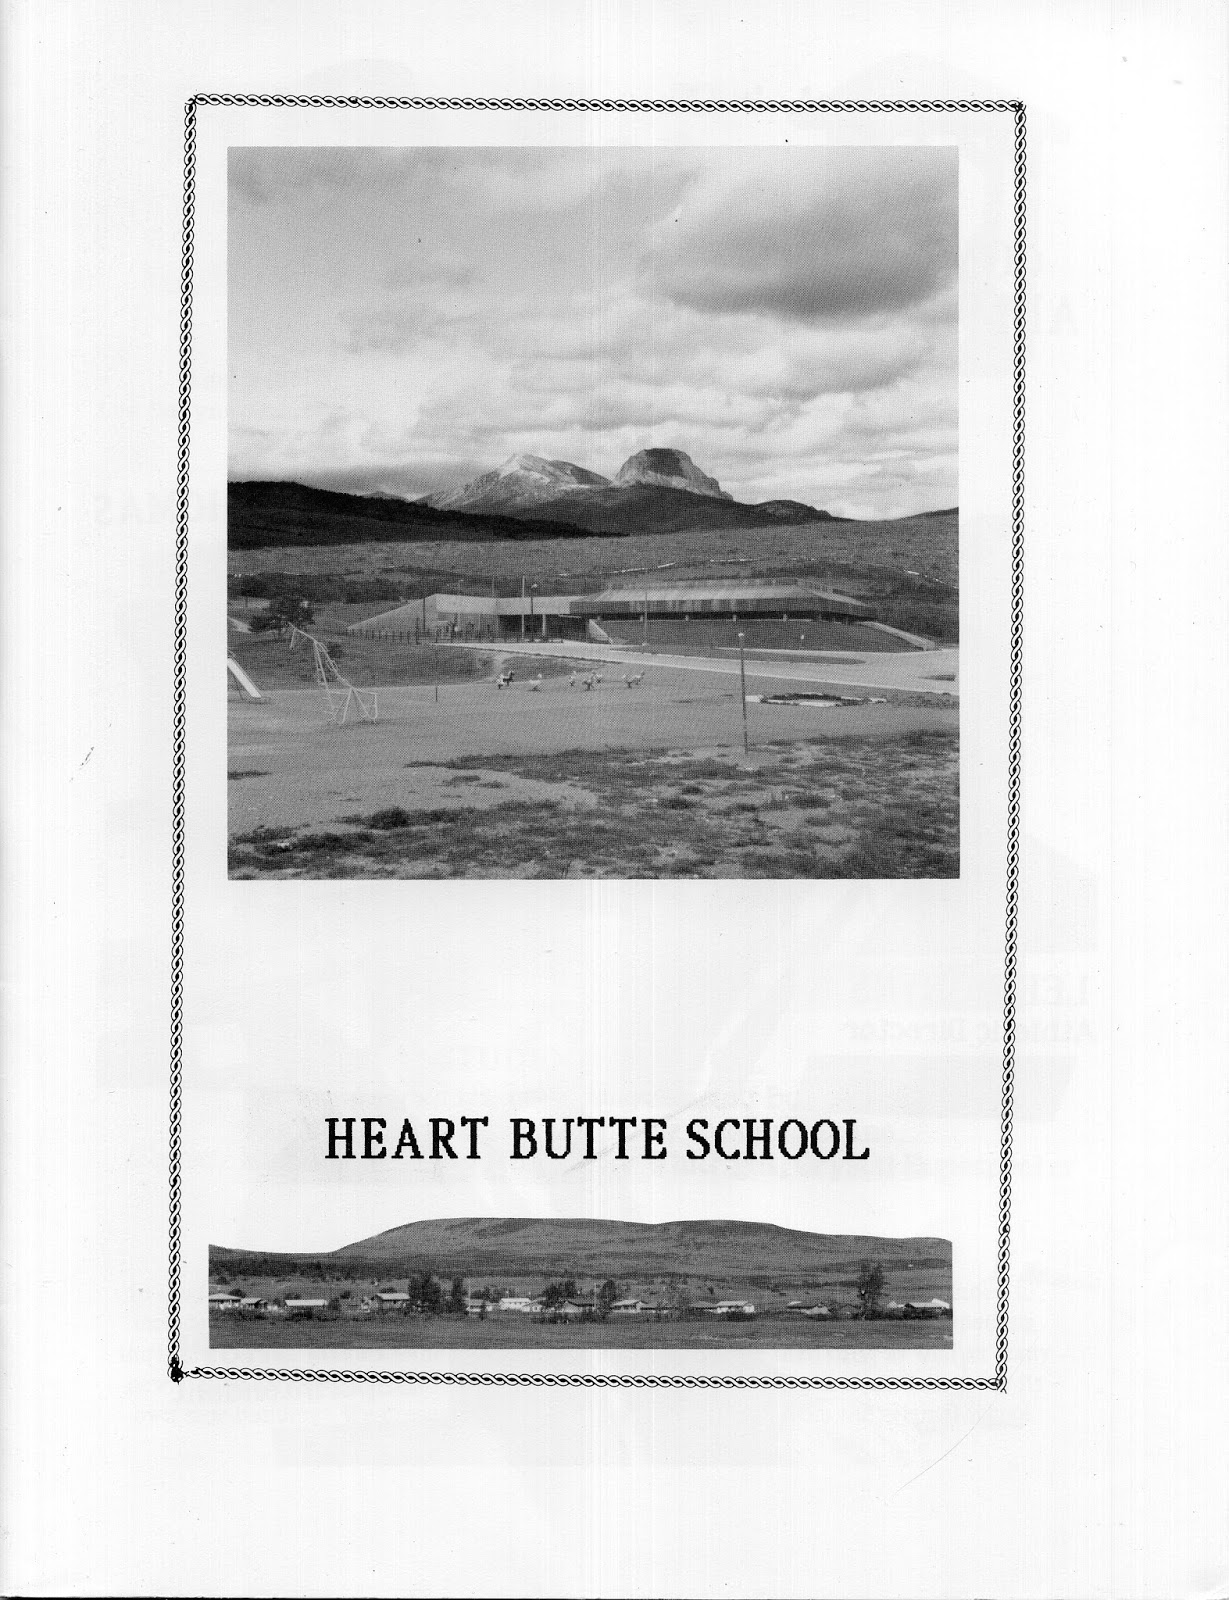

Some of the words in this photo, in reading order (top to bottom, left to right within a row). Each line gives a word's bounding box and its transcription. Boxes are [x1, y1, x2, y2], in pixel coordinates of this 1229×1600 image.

[325, 1116, 488, 1159] HEART
[510, 1117, 667, 1159] BUTTE
[687, 1119, 869, 1159] SCHOOL
